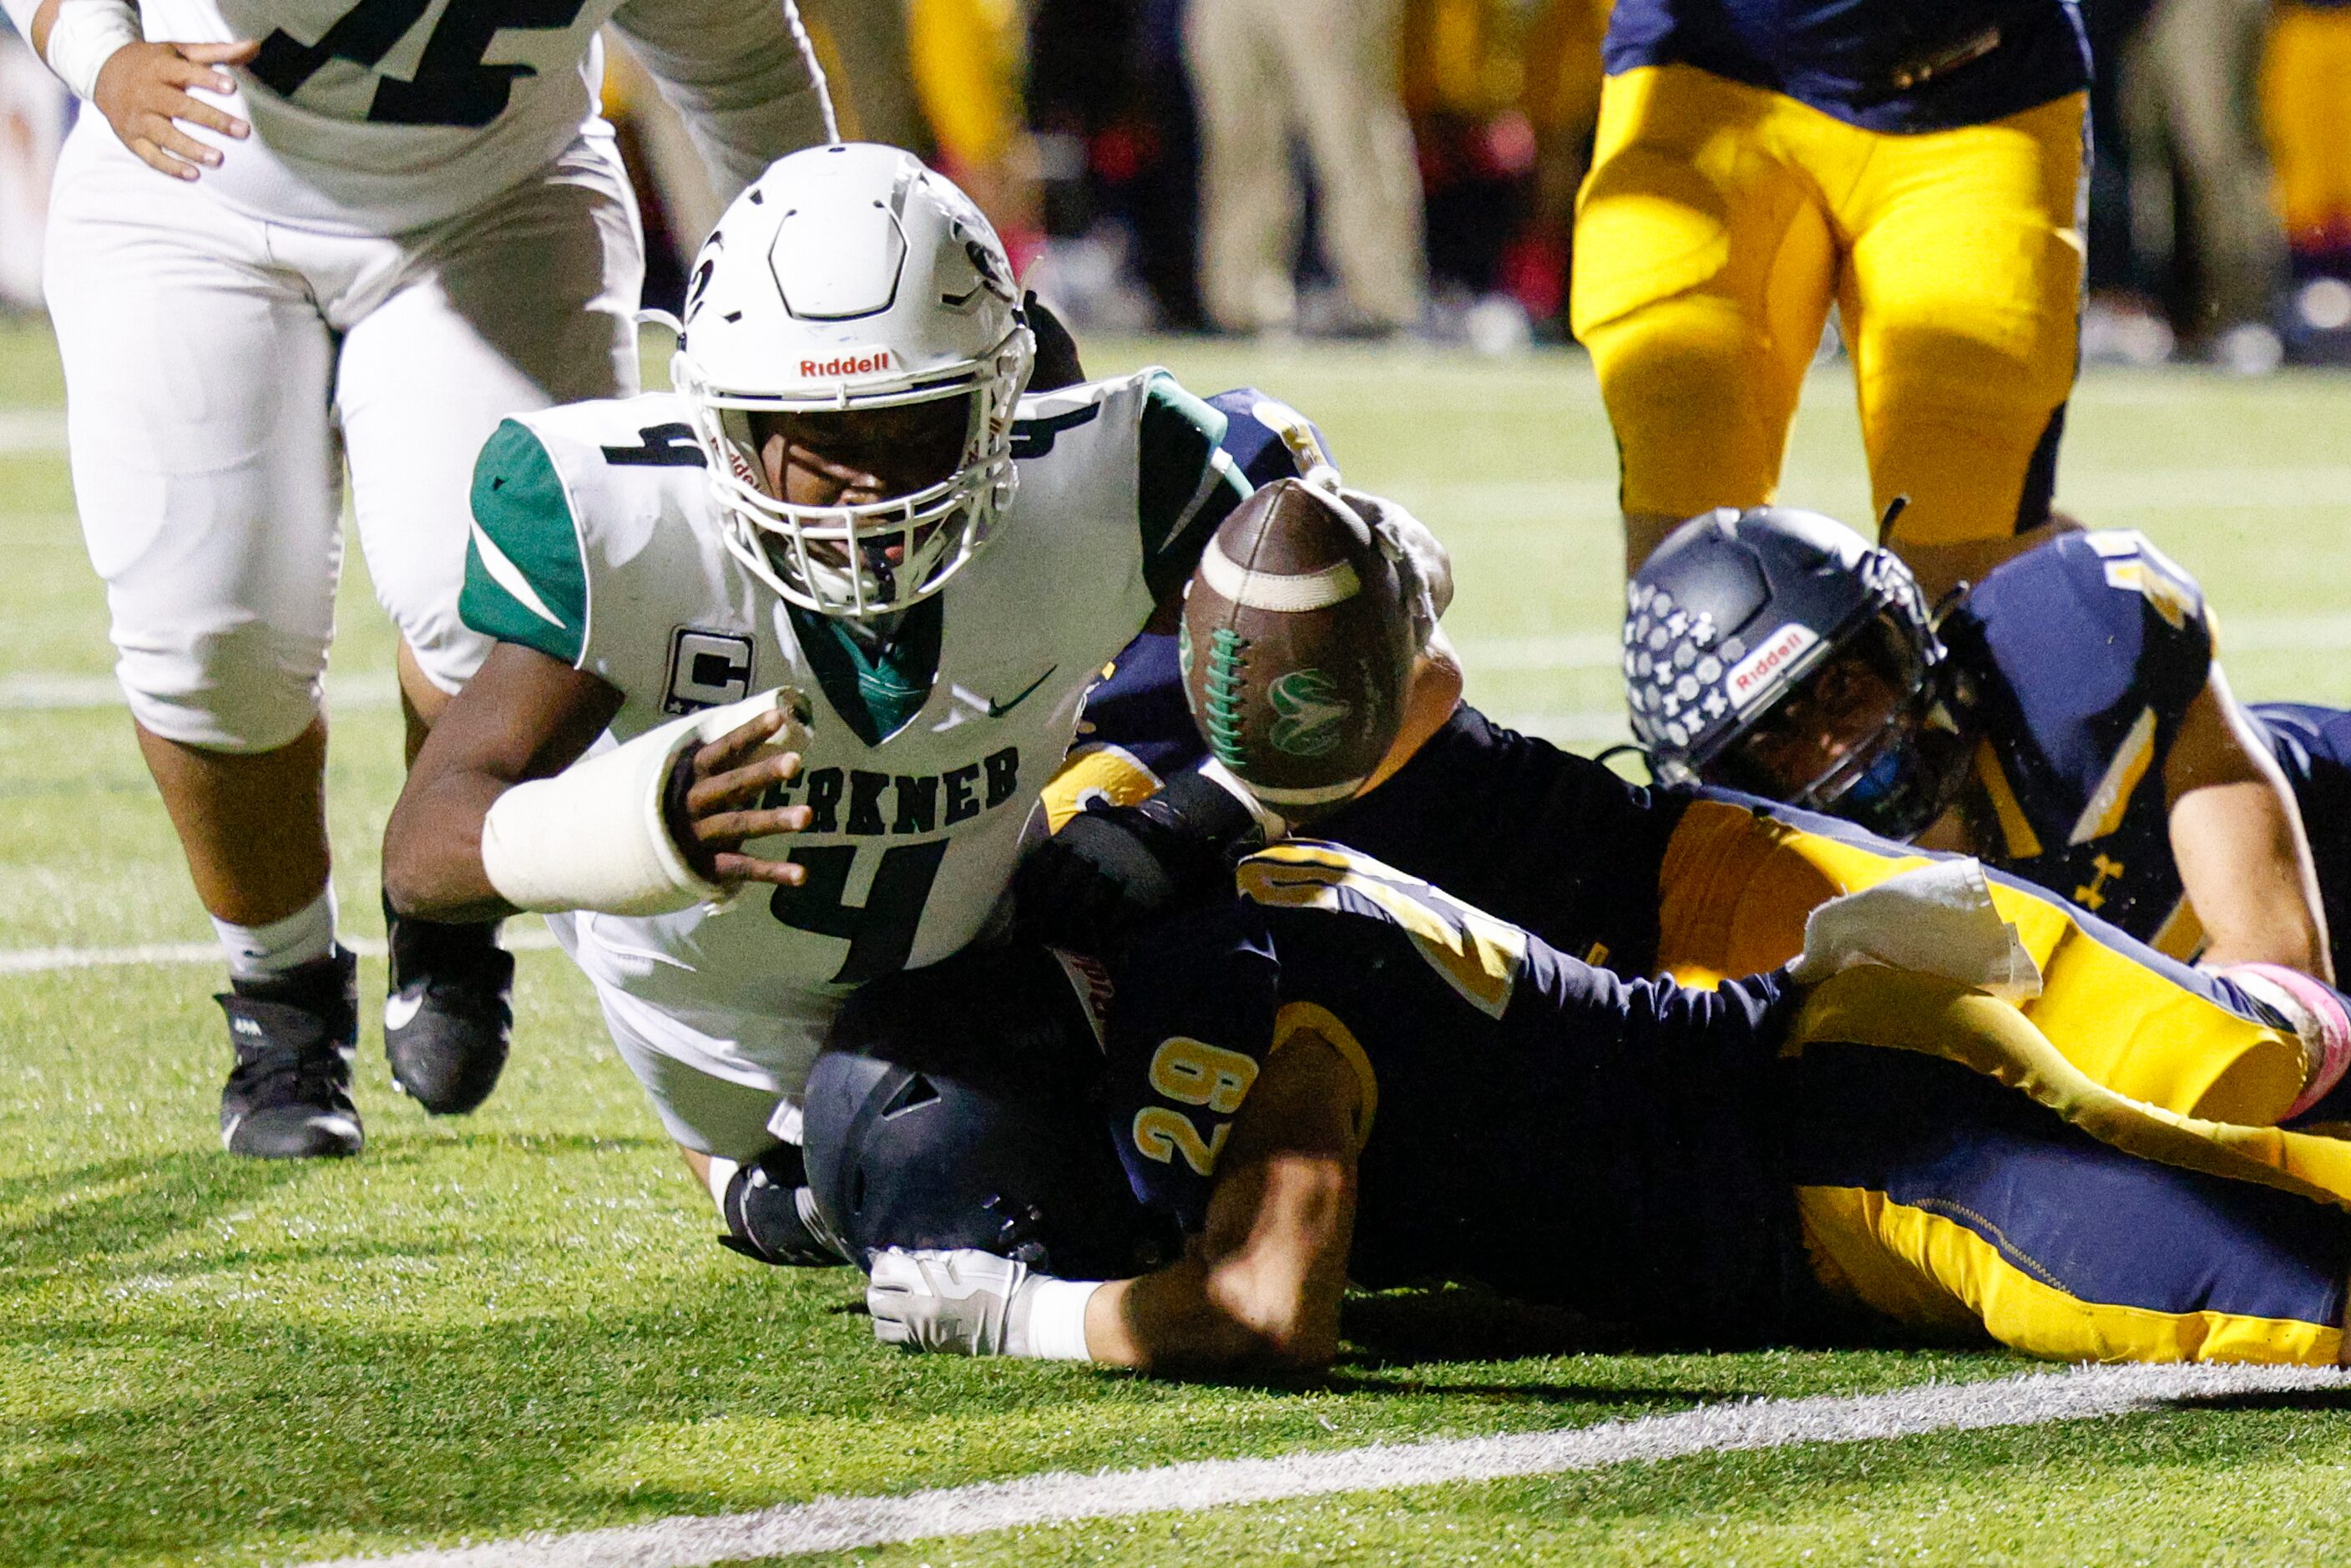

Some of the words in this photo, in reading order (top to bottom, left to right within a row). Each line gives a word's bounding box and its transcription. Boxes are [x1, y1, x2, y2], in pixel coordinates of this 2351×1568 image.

[800, 352, 889, 377] Riddell
[672, 634, 750, 706] C
[1737, 633, 1802, 691] Riddell
[748, 747, 1019, 835] ERKNER
[769, 837, 951, 984] 4
[1132, 1036, 1260, 1176] 29
